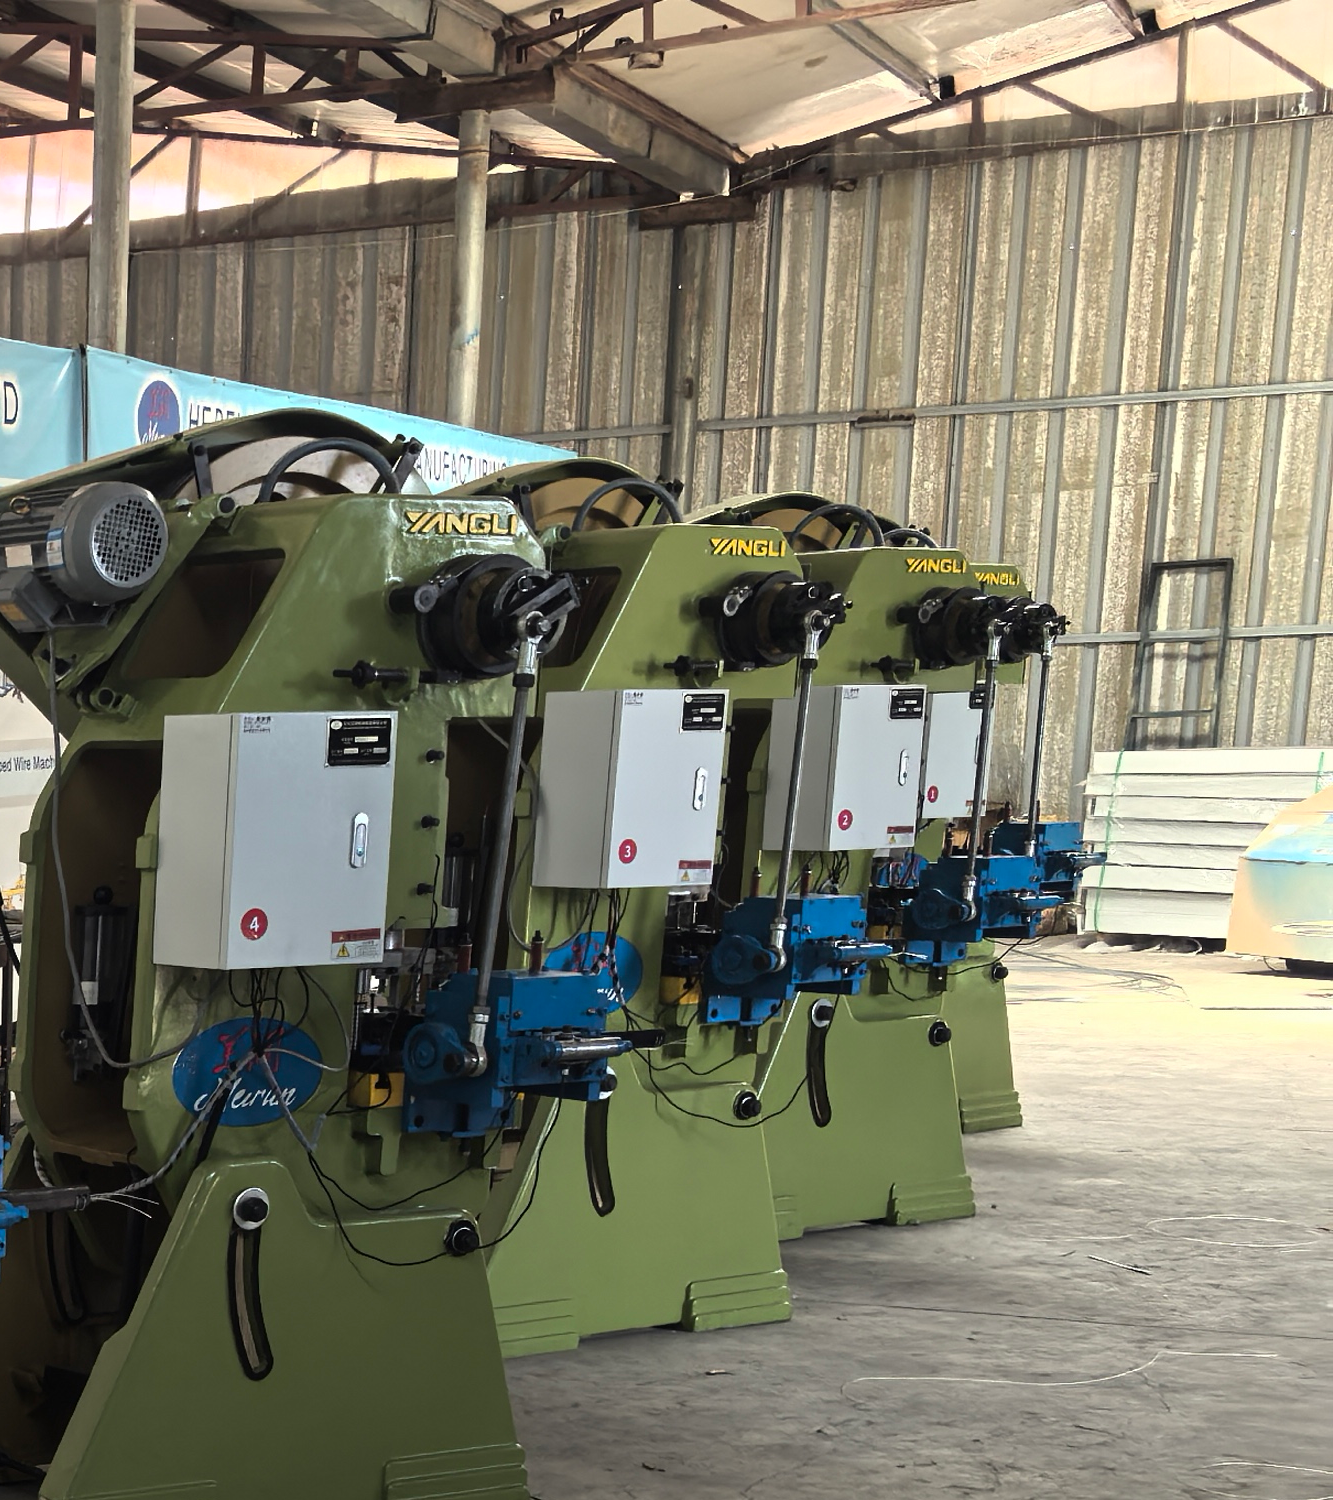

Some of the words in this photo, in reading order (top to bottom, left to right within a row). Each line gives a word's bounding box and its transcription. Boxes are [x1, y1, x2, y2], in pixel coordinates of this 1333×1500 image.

[405, 510, 518, 535] YANGLI
[710, 537, 786, 557] YANGLI
[905, 557, 967, 574] YANGLI
[930, 789, 936, 800] 1
[841, 814, 849, 827] 2
[623, 844, 633, 859] 3
[248, 915, 260, 934] 4
